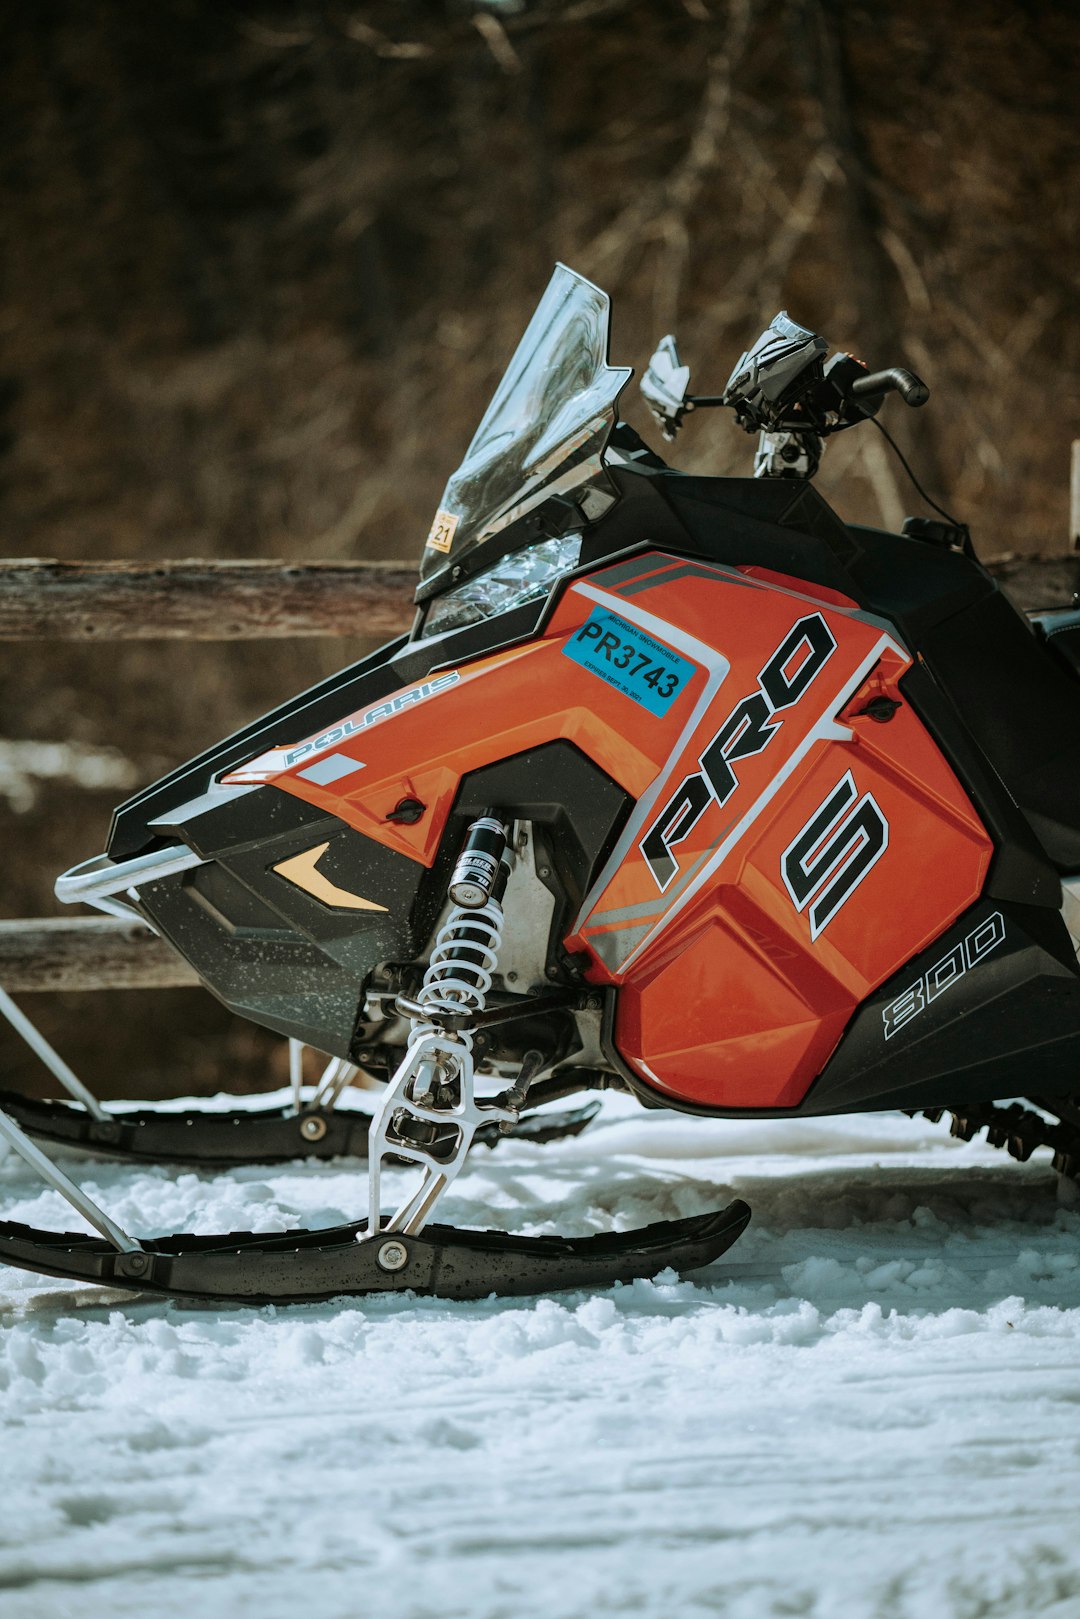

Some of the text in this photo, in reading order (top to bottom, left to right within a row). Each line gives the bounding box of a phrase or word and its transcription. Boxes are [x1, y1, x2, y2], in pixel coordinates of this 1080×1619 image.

[434, 525, 450, 543] 21
[576, 621, 680, 698] PR3743
[607, 615, 680, 665] MICHIGAN SNOWMOBILE
[284, 670, 461, 768] POLARIS
[584, 660, 607, 680] EXPIRES
[607, 675, 622, 690] SEPT.
[629, 689, 643, 702] 2021
[638, 610, 838, 894] PRO
[882, 911, 1006, 1041] 800
